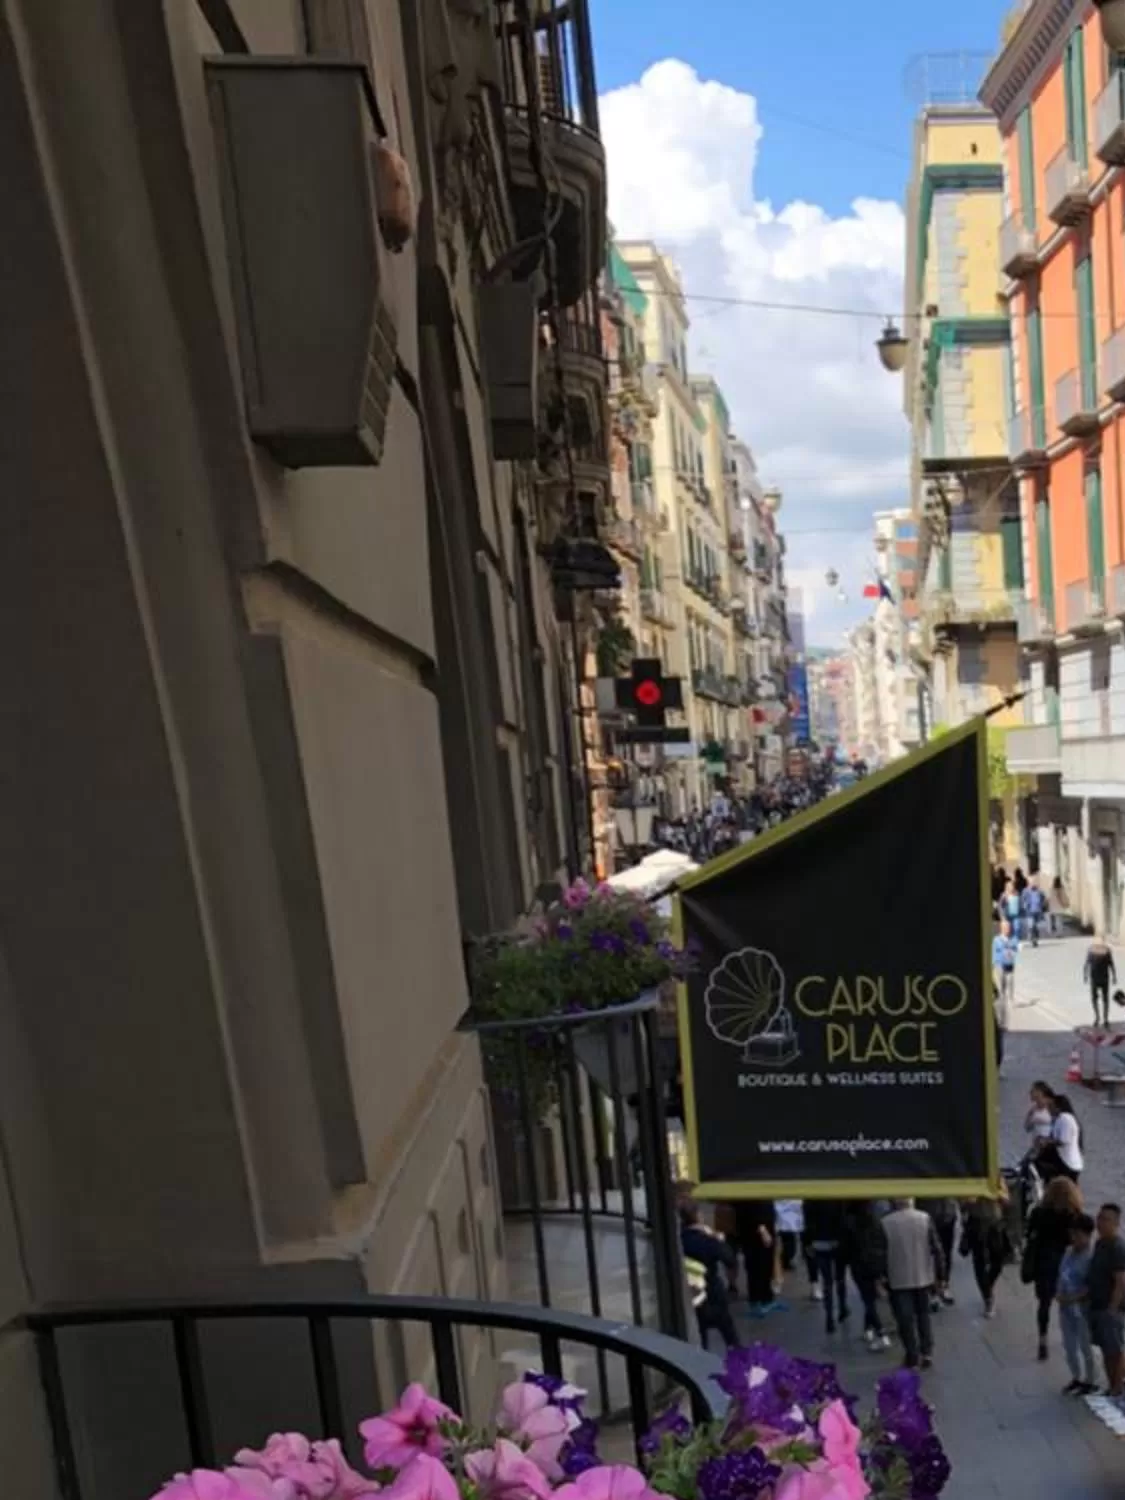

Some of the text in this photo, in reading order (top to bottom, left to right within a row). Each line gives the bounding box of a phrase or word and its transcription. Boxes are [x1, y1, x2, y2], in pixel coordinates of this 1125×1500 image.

[794, 974, 968, 1017] CARUSO
[826, 1021, 940, 1063] PLACE
[737, 1071, 944, 1088] BOUTIQUE & WELLNESS SUITES
[757, 1132, 930, 1158] www.carusoplace.com
